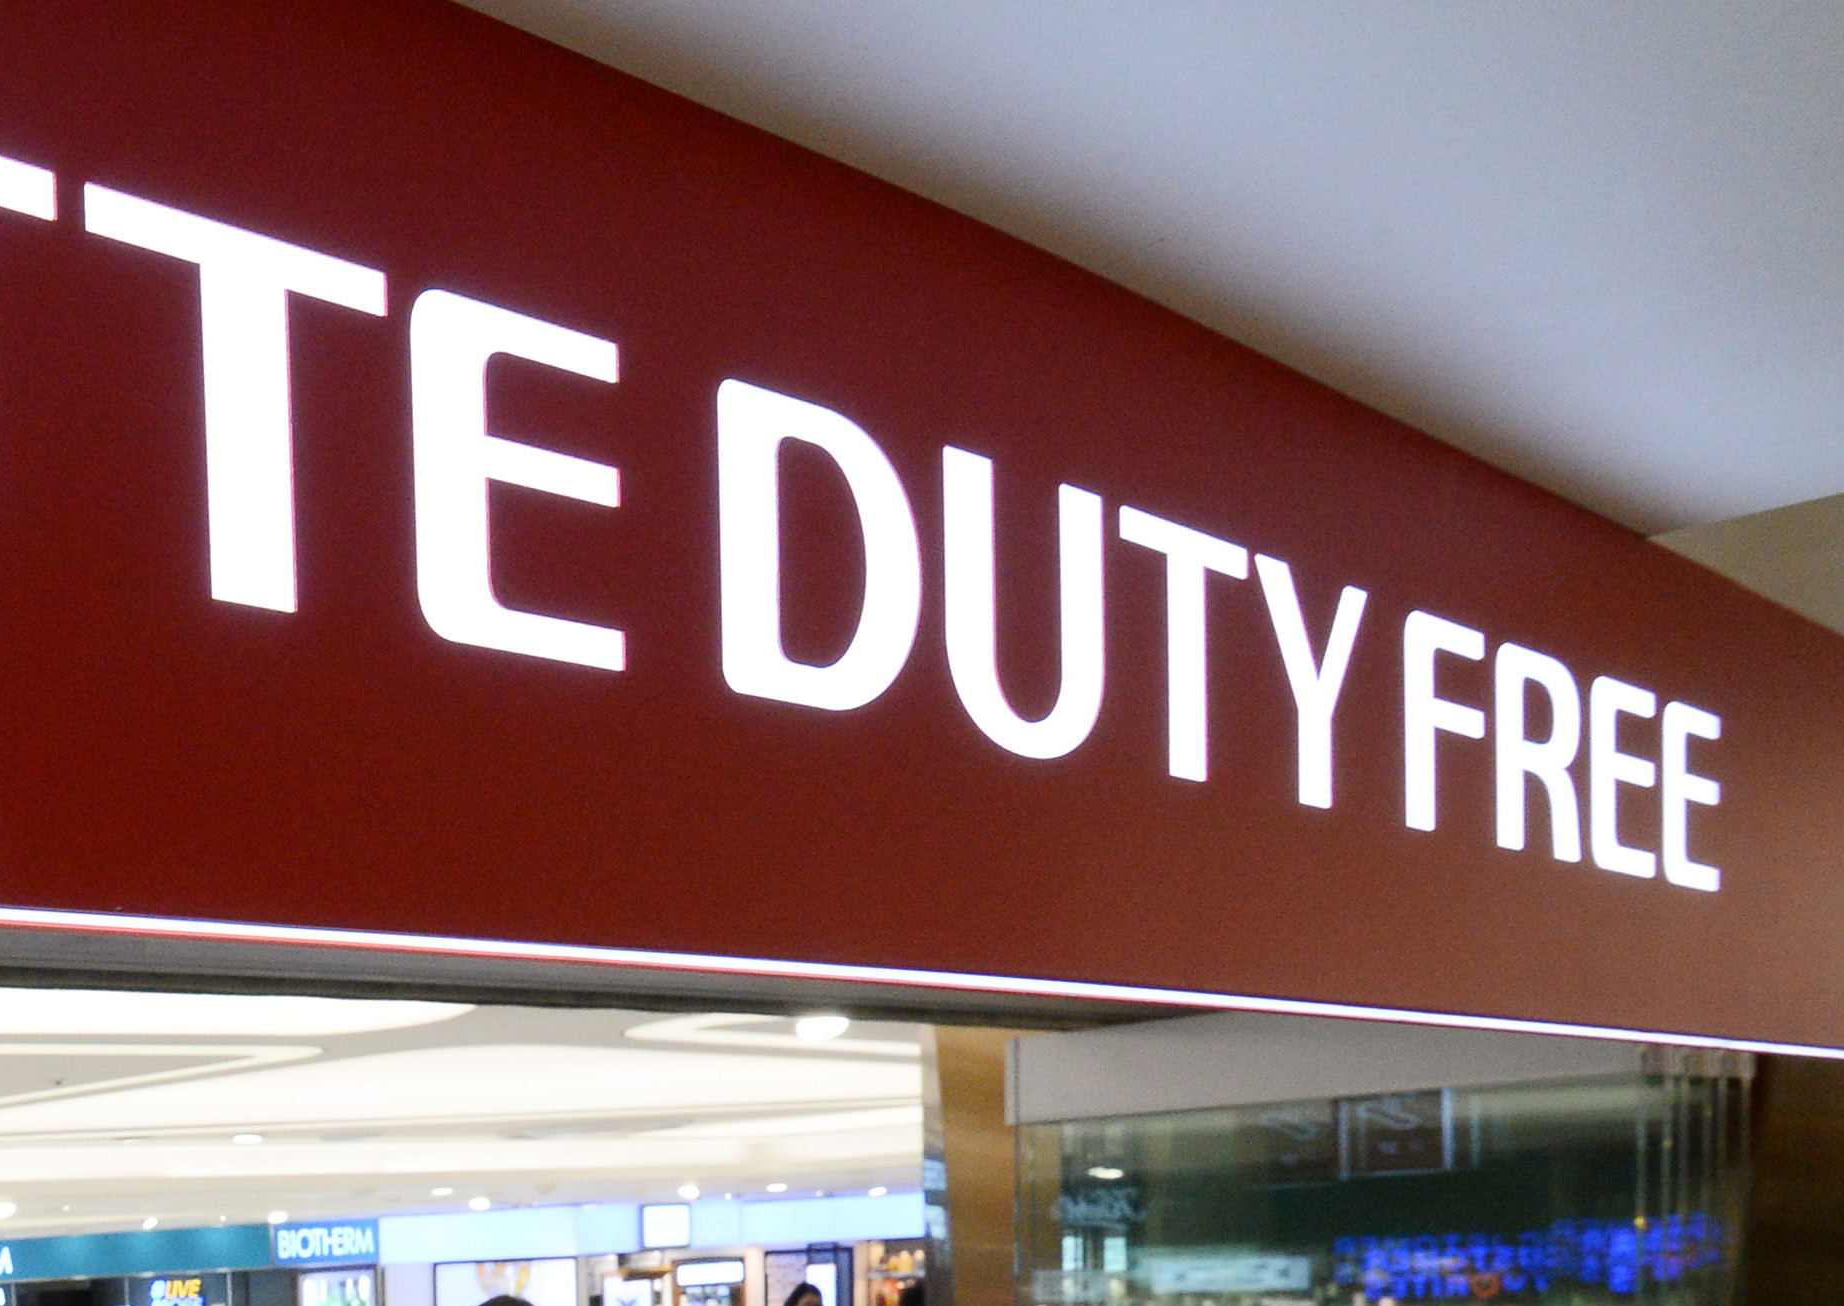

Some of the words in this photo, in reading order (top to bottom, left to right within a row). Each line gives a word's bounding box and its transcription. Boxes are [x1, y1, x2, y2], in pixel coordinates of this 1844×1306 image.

[715, 377, 1369, 812] DUTY
[1402, 609, 1724, 894] FREE
[277, 1226, 375, 1260] BIOTHERM
